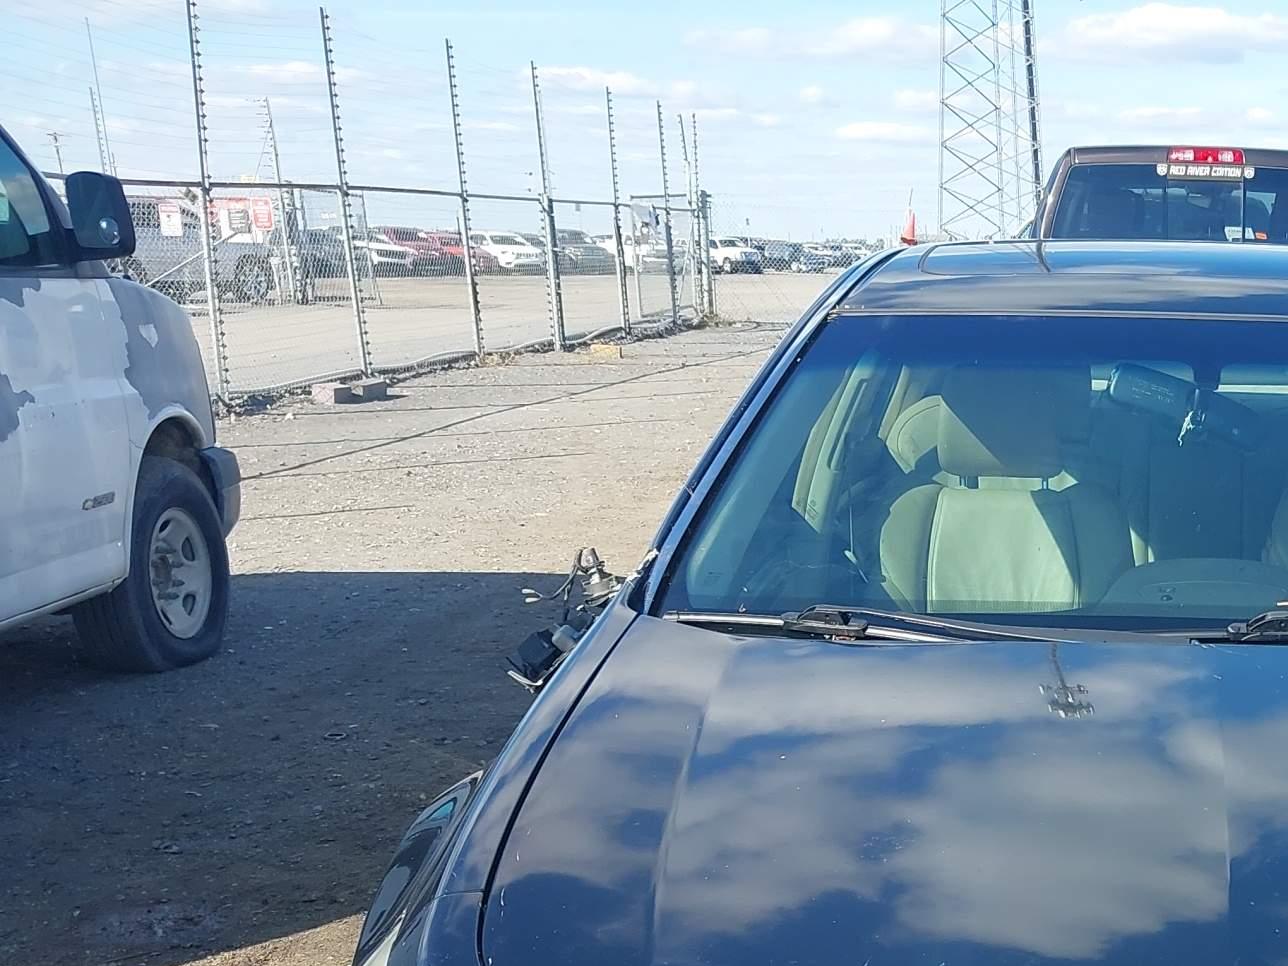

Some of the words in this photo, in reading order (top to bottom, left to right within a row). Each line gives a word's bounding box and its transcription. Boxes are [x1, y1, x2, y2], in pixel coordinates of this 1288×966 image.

[1169, 164, 1185, 176] RED
[1187, 165, 1210, 177] RIVER
[1211, 166, 1242, 178] EDITION
